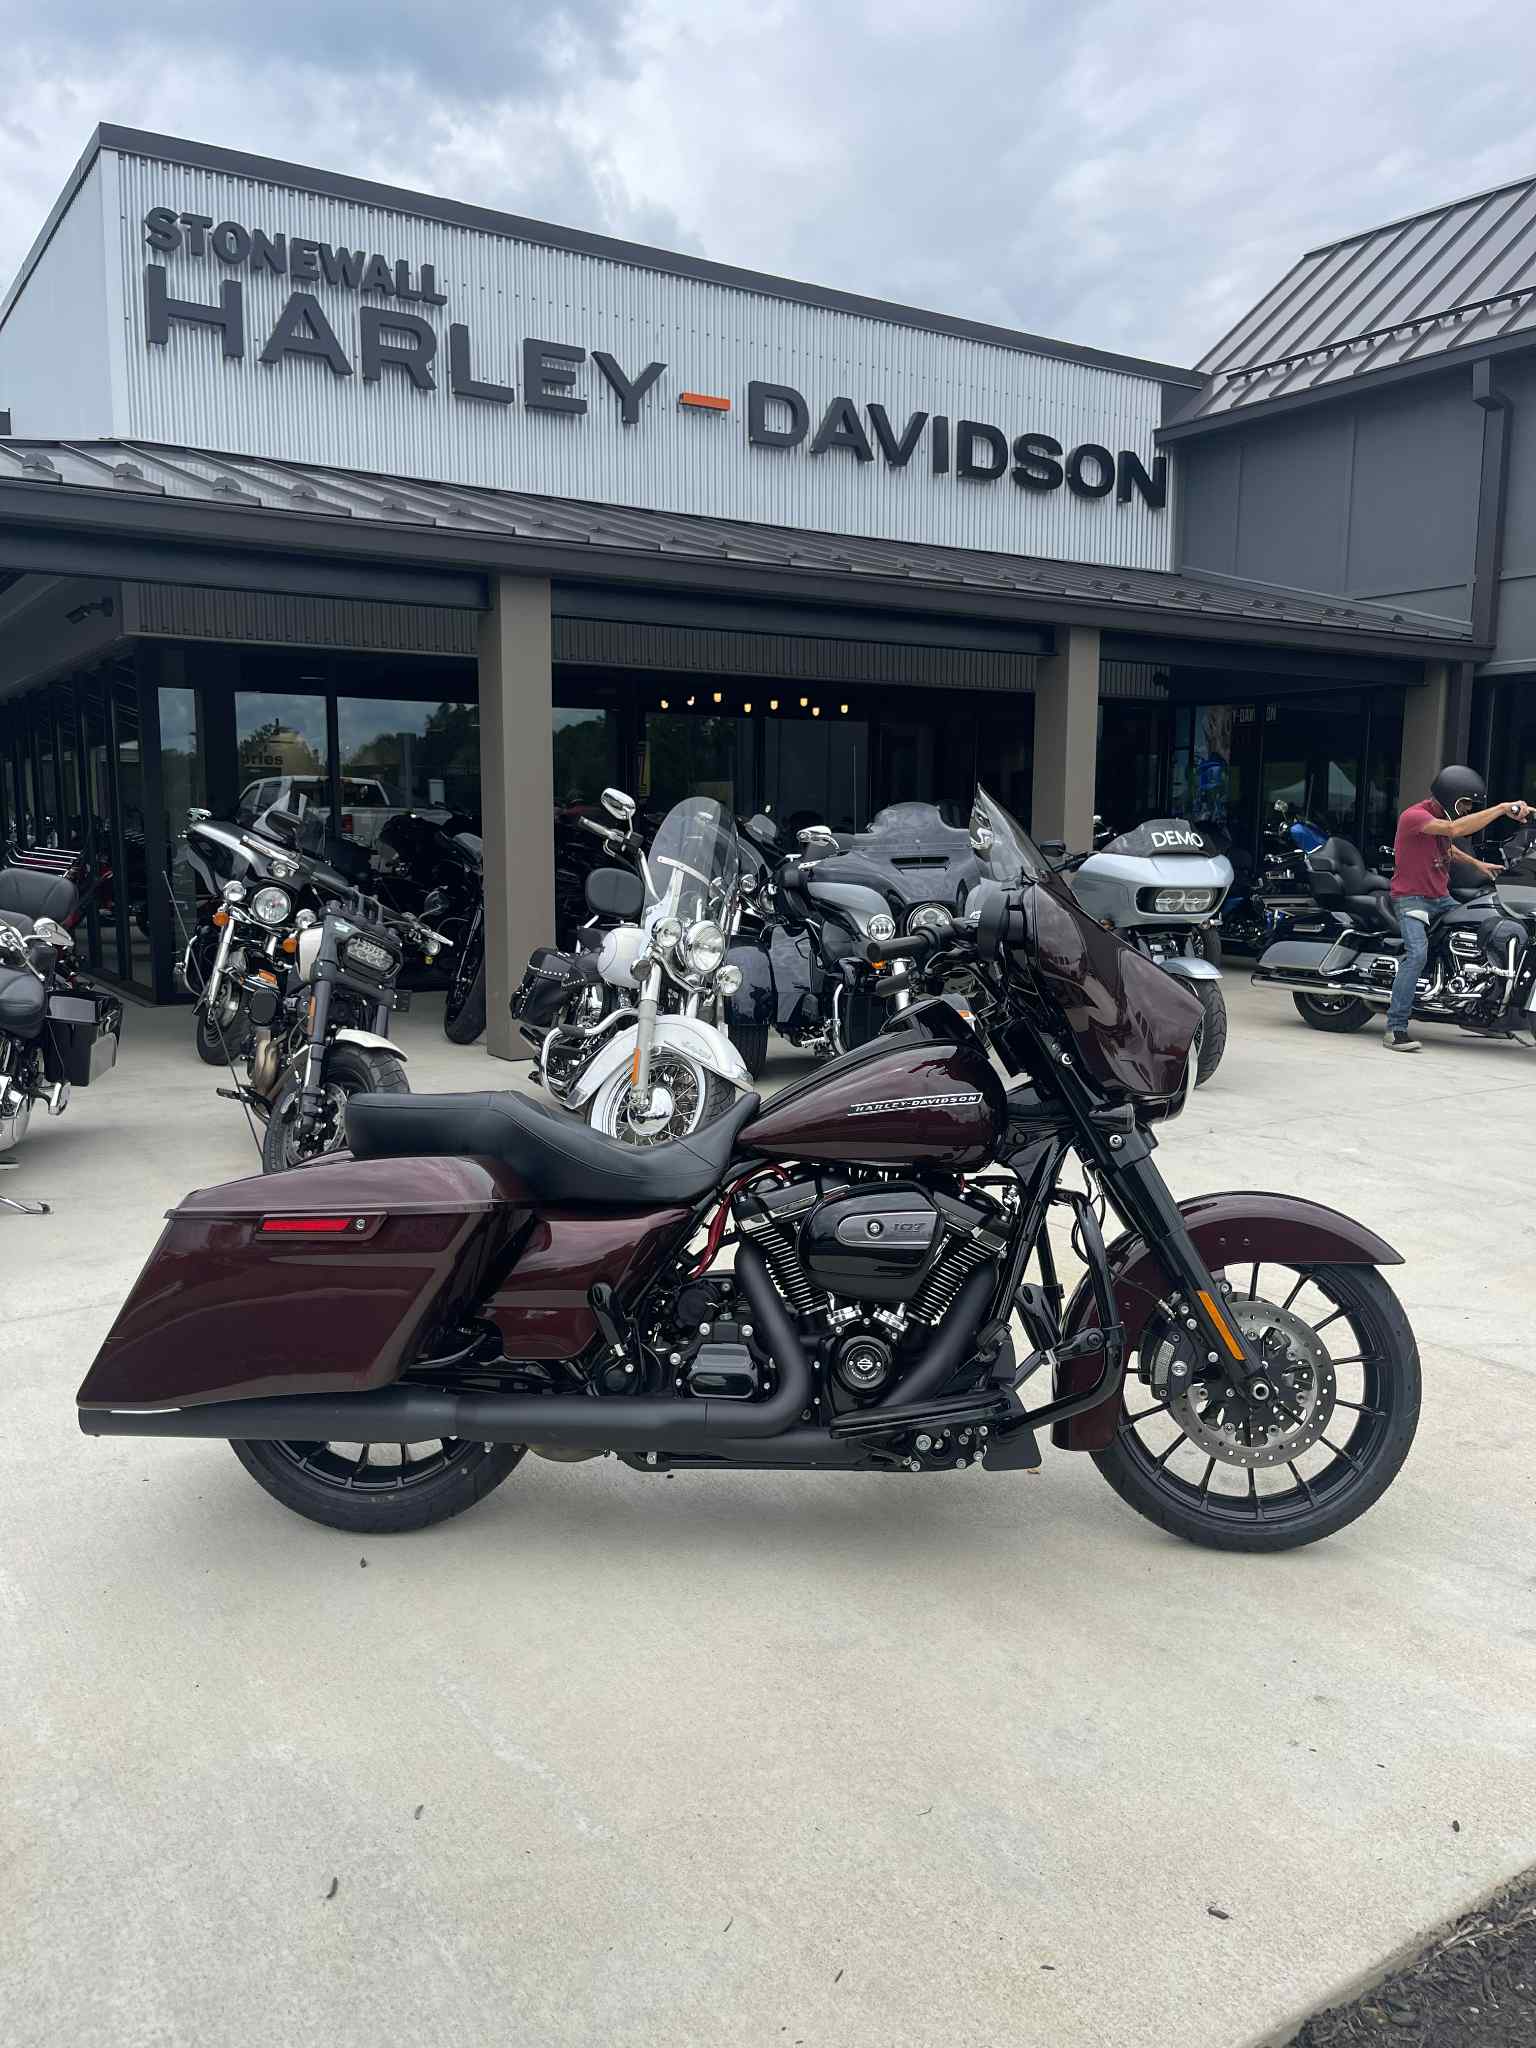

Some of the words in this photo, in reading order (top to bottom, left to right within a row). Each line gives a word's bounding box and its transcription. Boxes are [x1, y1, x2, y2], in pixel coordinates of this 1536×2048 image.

[145, 206, 448, 306] STONEWALL
[146, 263, 1167, 509] HARLEY-DAVIDSON
[1151, 830, 1204, 848] DEMO
[855, 1095, 978, 1113] HARLEY-DAVIDSON
